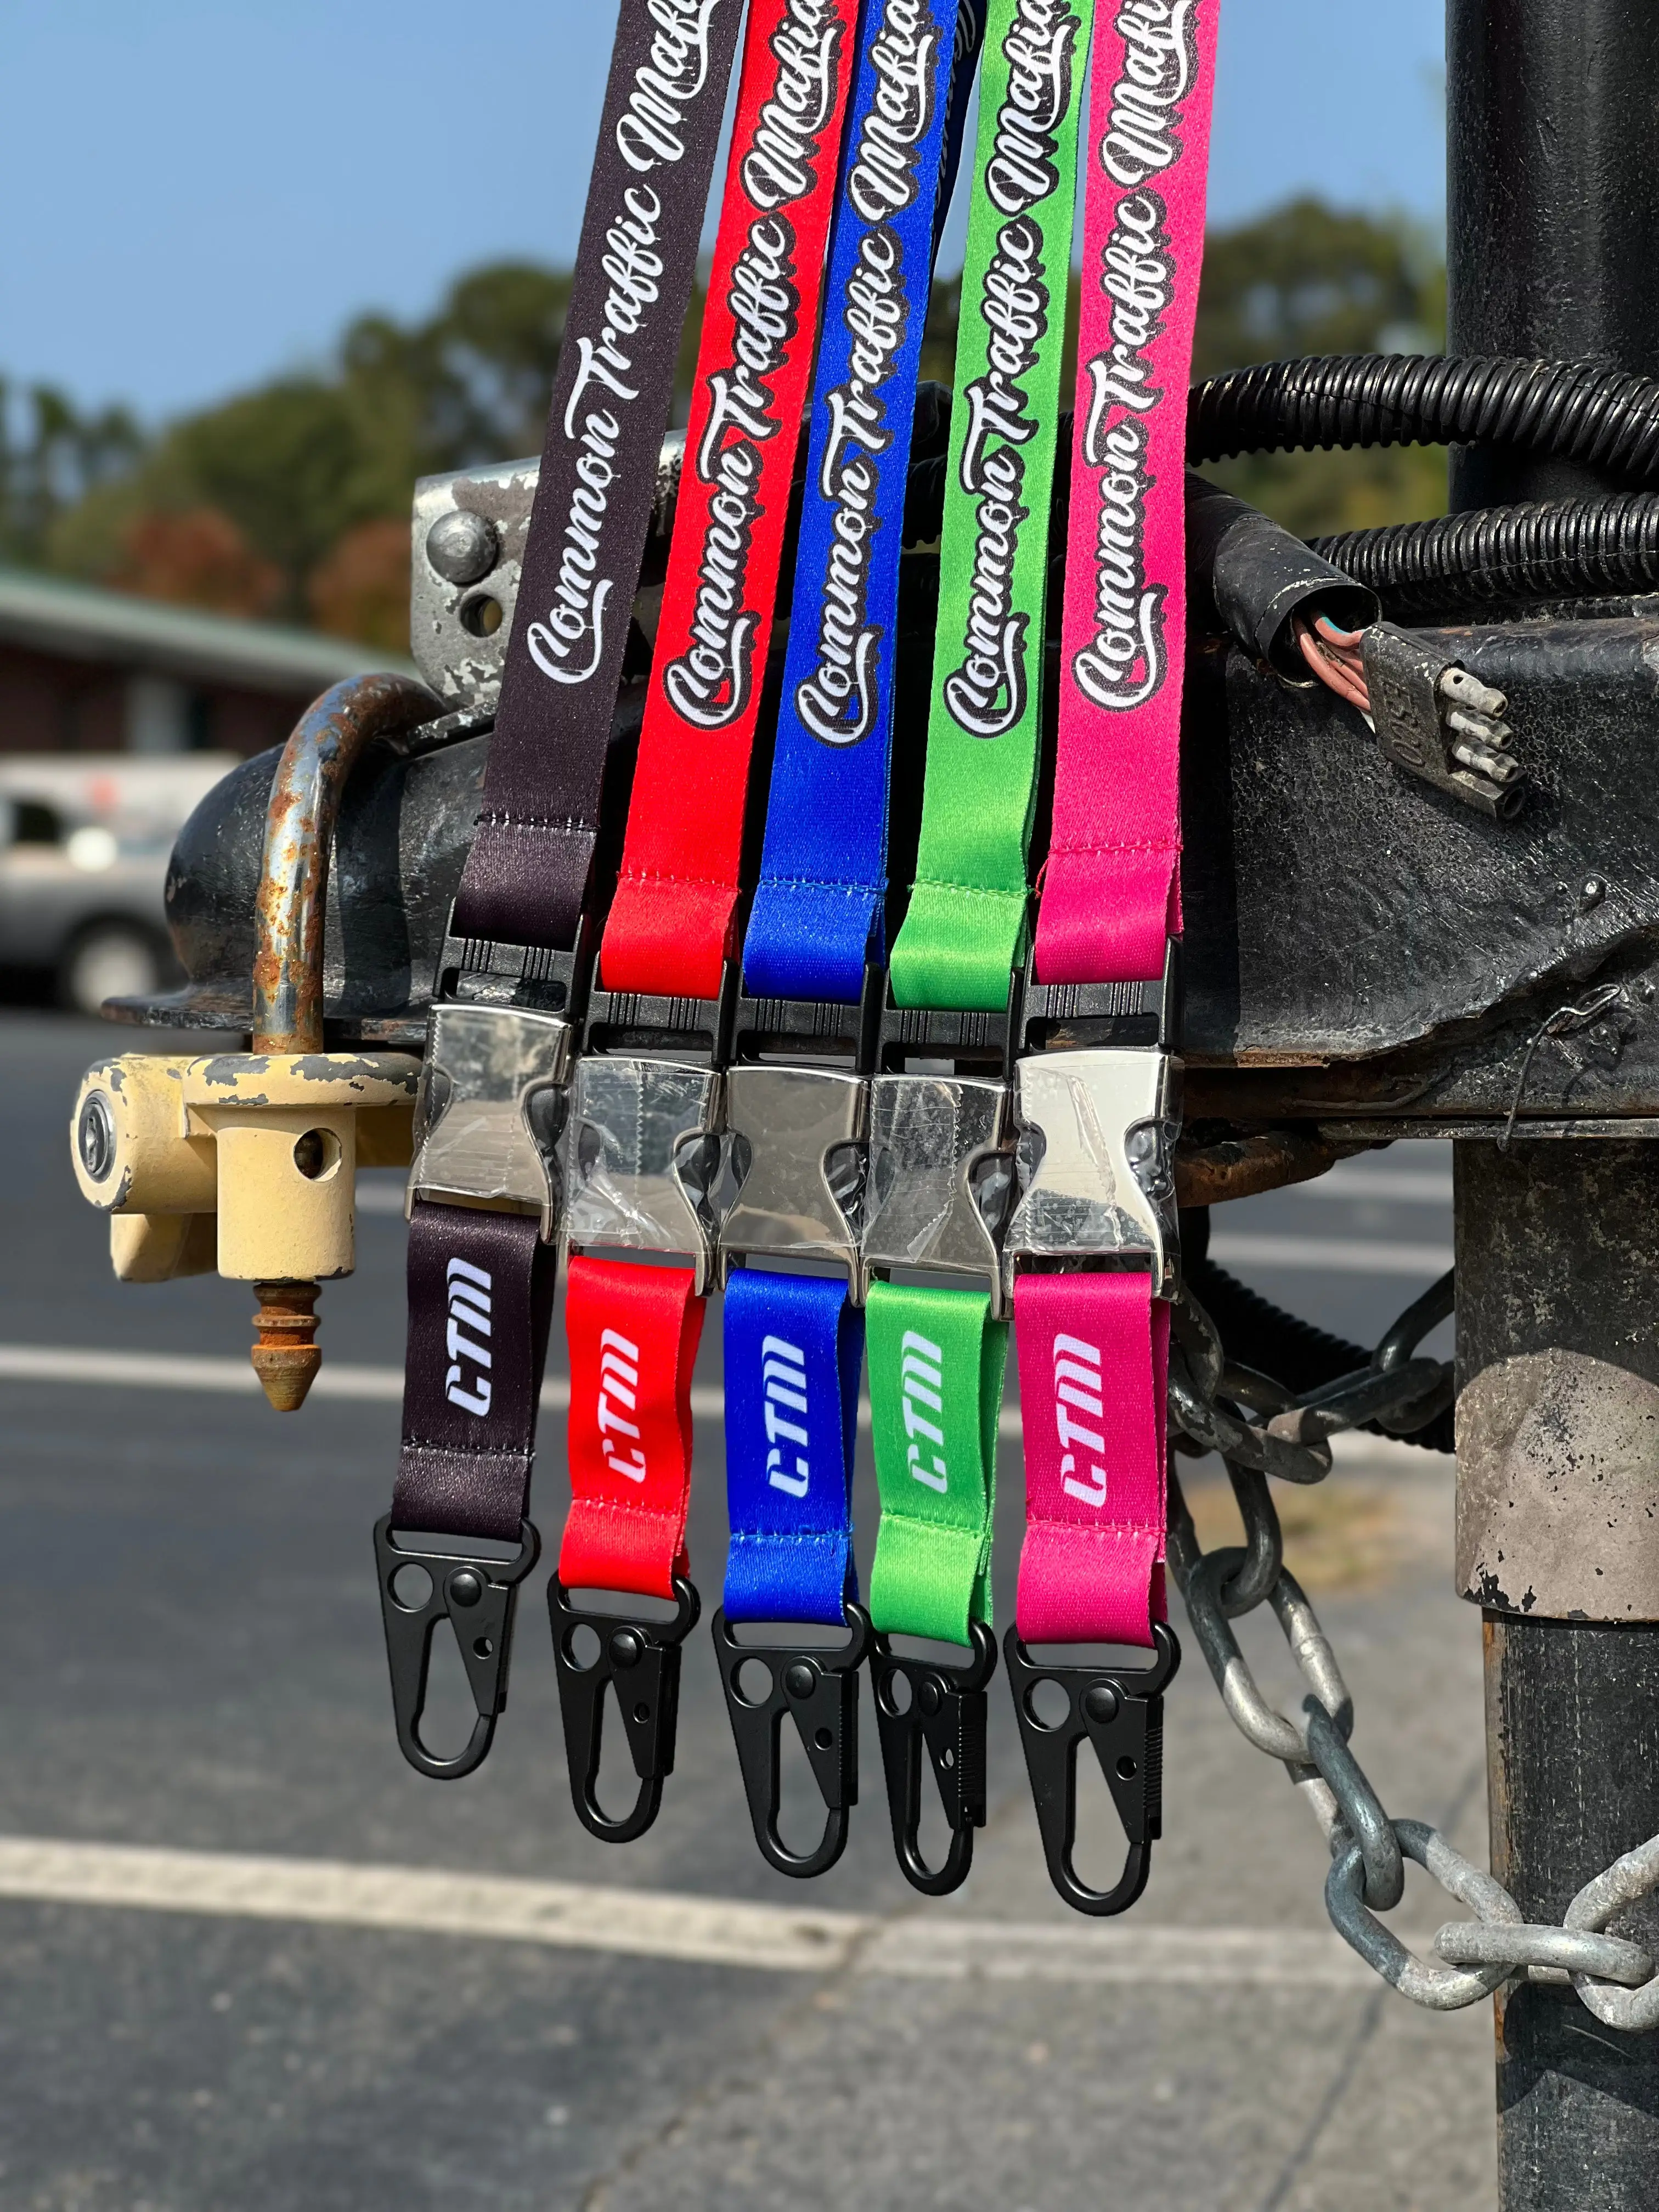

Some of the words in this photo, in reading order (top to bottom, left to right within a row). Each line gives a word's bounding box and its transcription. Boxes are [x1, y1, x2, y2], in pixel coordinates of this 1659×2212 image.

[850, 0, 935, 222] Mafia
[1101, 0, 1193, 186] Mafi
[565, 183, 664, 439] Traffic
[700, 219, 791, 479] Traffic
[822, 233, 902, 497] Traffic
[963, 223, 1040, 490] Traffic
[1084, 193, 1174, 467] Traffic
[527, 408, 622, 684] Common
[667, 447, 755, 726] Common
[798, 462, 876, 743] Common
[946, 454, 1022, 734] Common
[1072, 416, 1161, 712] Common
[445, 1257, 492, 1417] CTM
[597, 1328, 646, 1483] CTM
[761, 1335, 809, 1498] CTM
[901, 1330, 947, 1494] CTM
[1053, 1333, 1107, 1508] CTM
